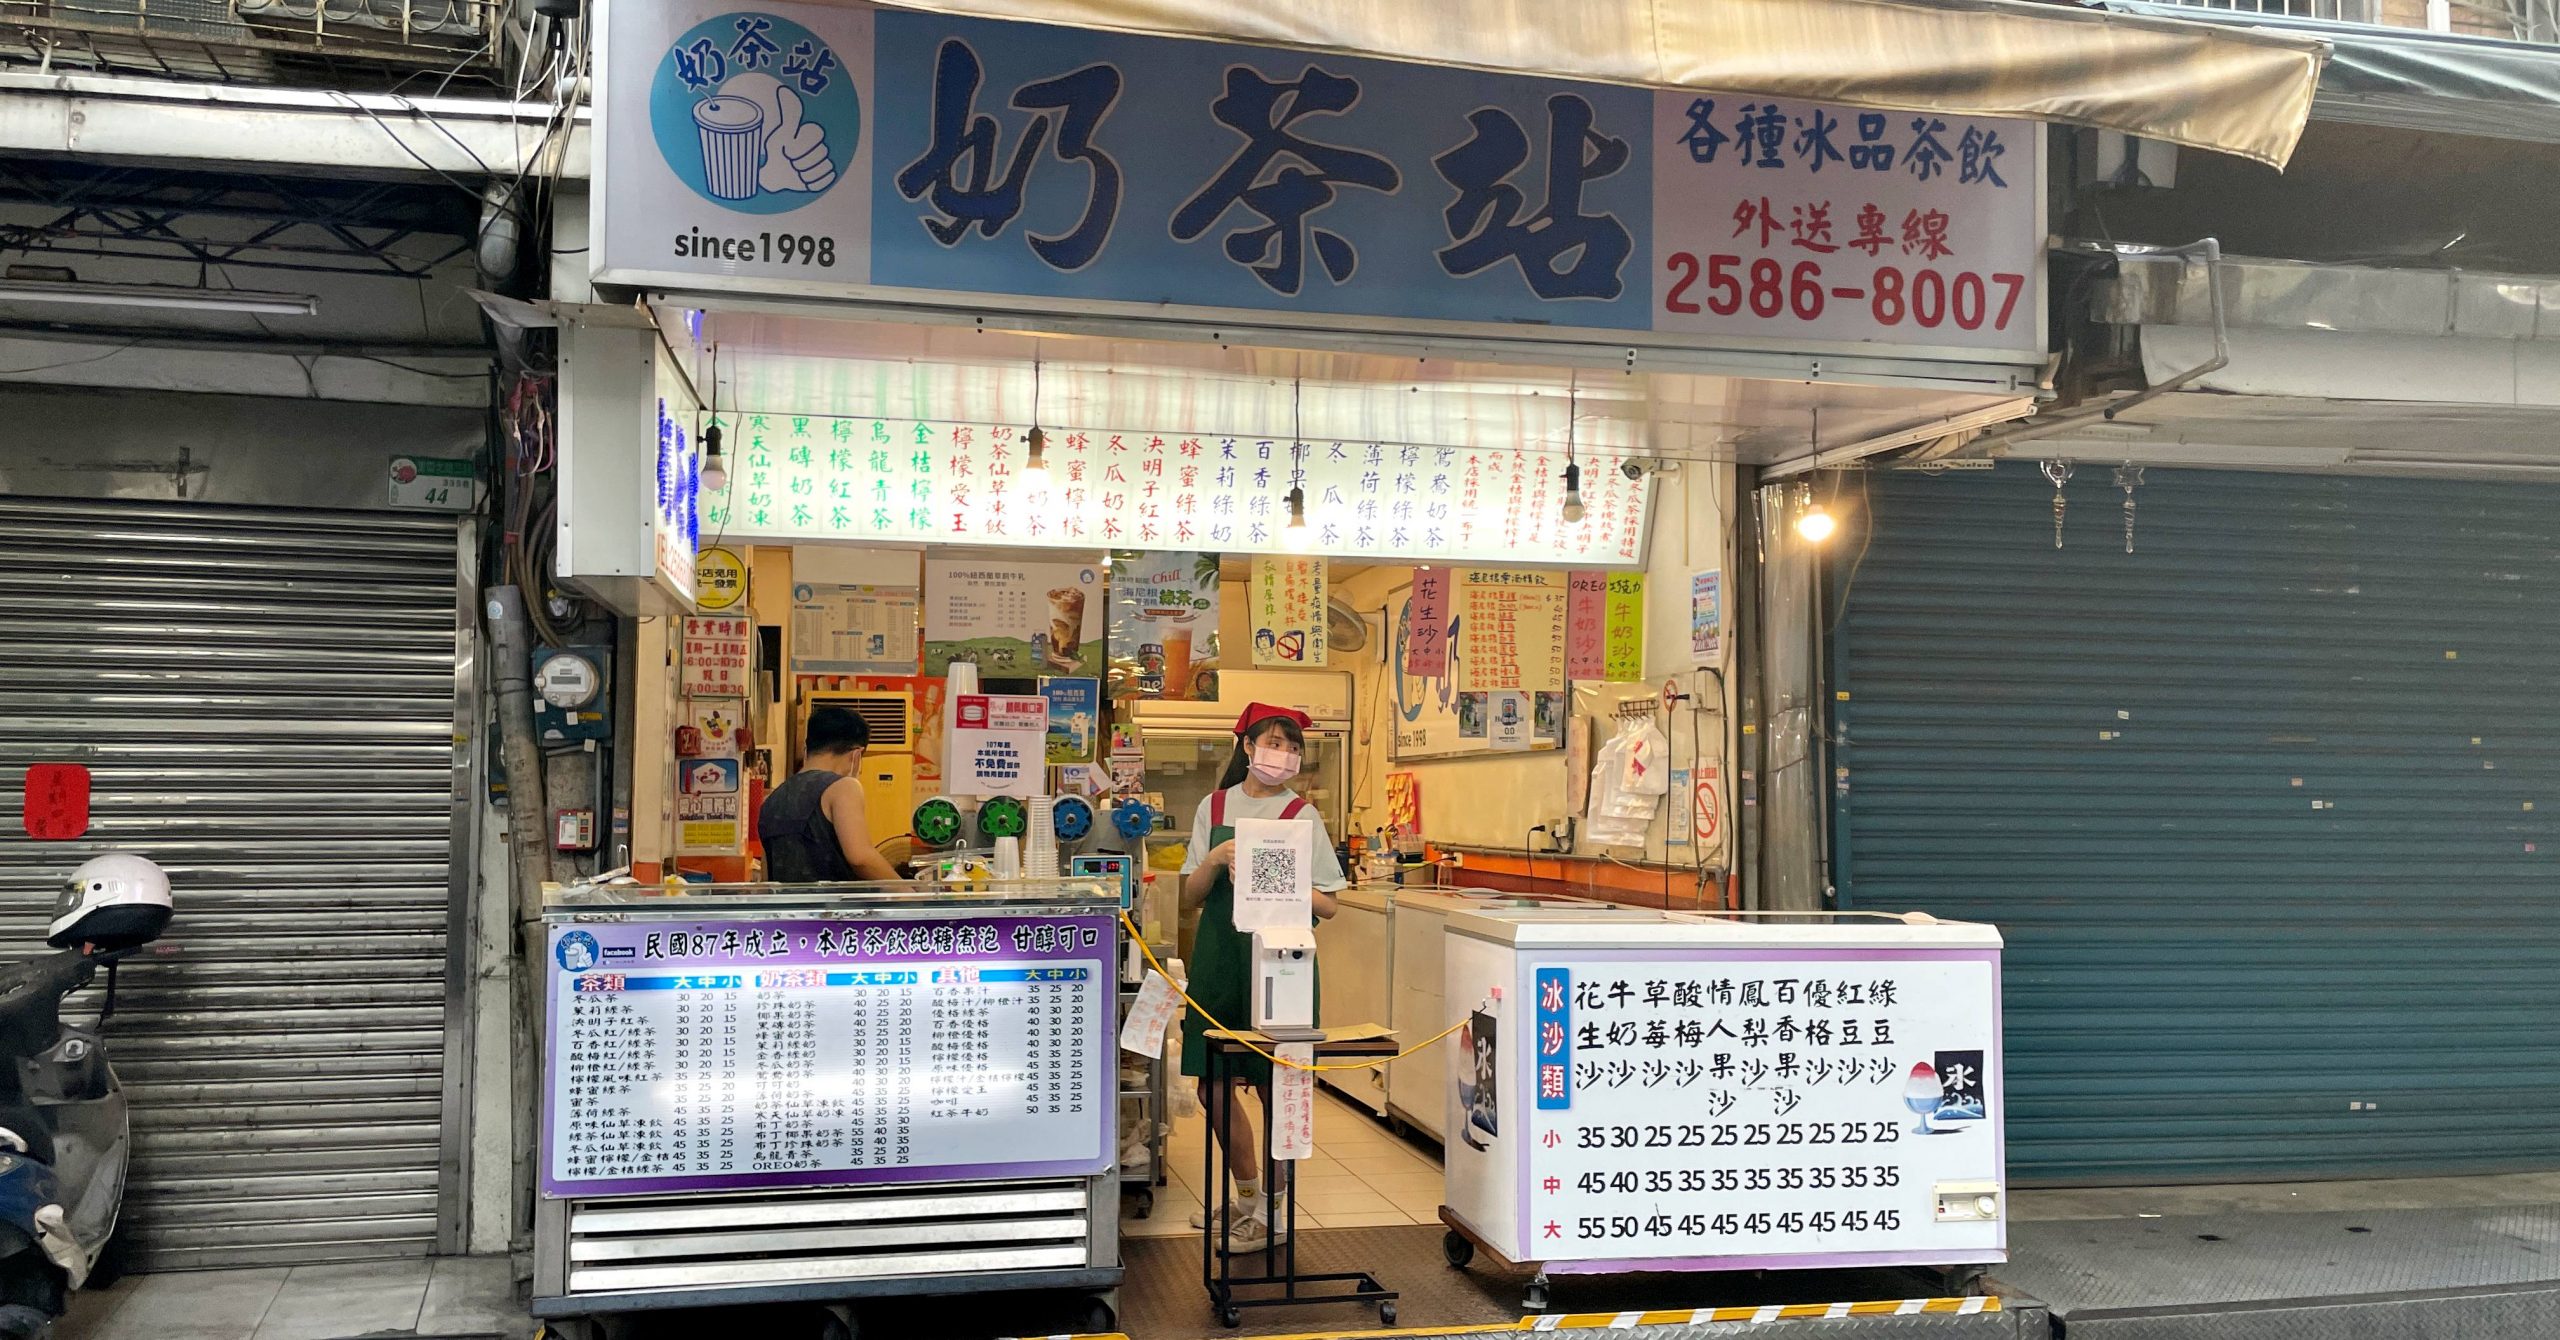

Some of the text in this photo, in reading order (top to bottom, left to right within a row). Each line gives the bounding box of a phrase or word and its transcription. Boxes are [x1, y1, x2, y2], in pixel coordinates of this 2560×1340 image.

[674, 18, 836, 94] 奶茶站
[896, 36, 1636, 300] 奶茶站
[674, 226, 836, 268] since1998
[1732, 197, 1955, 260] 外送專線
[1664, 251, 2025, 332] 2586-8007
[425, 487, 449, 505] 44
[747, 415, 772, 527] 寒天仙草奶凍
[789, 417, 815, 527] 黑磚奶茶
[828, 419, 854, 529] 檸檬紅茶
[868, 421, 894, 530] 烏龍青茶
[908, 422, 936, 530] 金桔檸檬
[950, 426, 974, 532] 檸檬愛玉
[1062, 433, 1091, 537] 蜂蜜檸檬
[1101, 435, 1127, 539] 冬瓜奶茶
[1138, 436, 1165, 541] 決明子紅茶
[1319, 444, 1347, 545] 冬瓜茶
[1424, 446, 1453, 548] 鴛鴦奶茶
[1152, 568, 1182, 585] Chill
[1572, 579, 1606, 592] OREO
[1609, 579, 1641, 595] 巧克力
[687, 619, 748, 637] 營業時間
[760, 969, 828, 988] 奶茶類
[938, 966, 981, 983] 其他
[1012, 925, 1099, 952] 甘醇可口
[580, 972, 626, 992] 茶類
[677, 1016, 689, 1024] 30
[701, 993, 713, 1001] 20
[724, 992, 736, 1000] 15
[677, 1027, 689, 1035] 30
[724, 1026, 736, 1034] 15
[724, 1037, 735, 1045] 15
[1542, 978, 1565, 1099] 冰沙類
[1575, 981, 1604, 1091] 花生沙
[1606, 981, 1637, 1089] 牛奶沙
[1642, 979, 1671, 1089] 草莓沙
[1673, 979, 1704, 1089] 酸梅沙
[1707, 979, 1737, 1117] 情人果沙
[1738, 978, 1770, 1088] 鳳梨沙
[1772, 979, 1802, 1116] 百香果沙
[1803, 979, 1834, 1086] 優格沙
[1837, 980, 1866, 1086] 紅豆沙
[1867, 979, 1898, 1086] 綠豆沙
[673, 1118, 686, 1126] 45
[721, 1116, 733, 1124] 25
[697, 1140, 709, 1148] 35
[721, 1139, 733, 1147] 25
[851, 1138, 863, 1146] 55
[897, 1136, 909, 1144] 35
[1027, 1106, 1038, 1114] 50
[1048, 1105, 1060, 1113] 35
[1070, 1104, 1082, 1112] 25
[1543, 1122, 1899, 1148] 小 35 30 25 25 25 25 25 25 25 25
[1543, 1166, 1899, 1193] 中 45 40 35 35 35 35 35 35 35 35
[1544, 1210, 1900, 1239] 大 55 50 45 45 45 45 45 45 45 45
